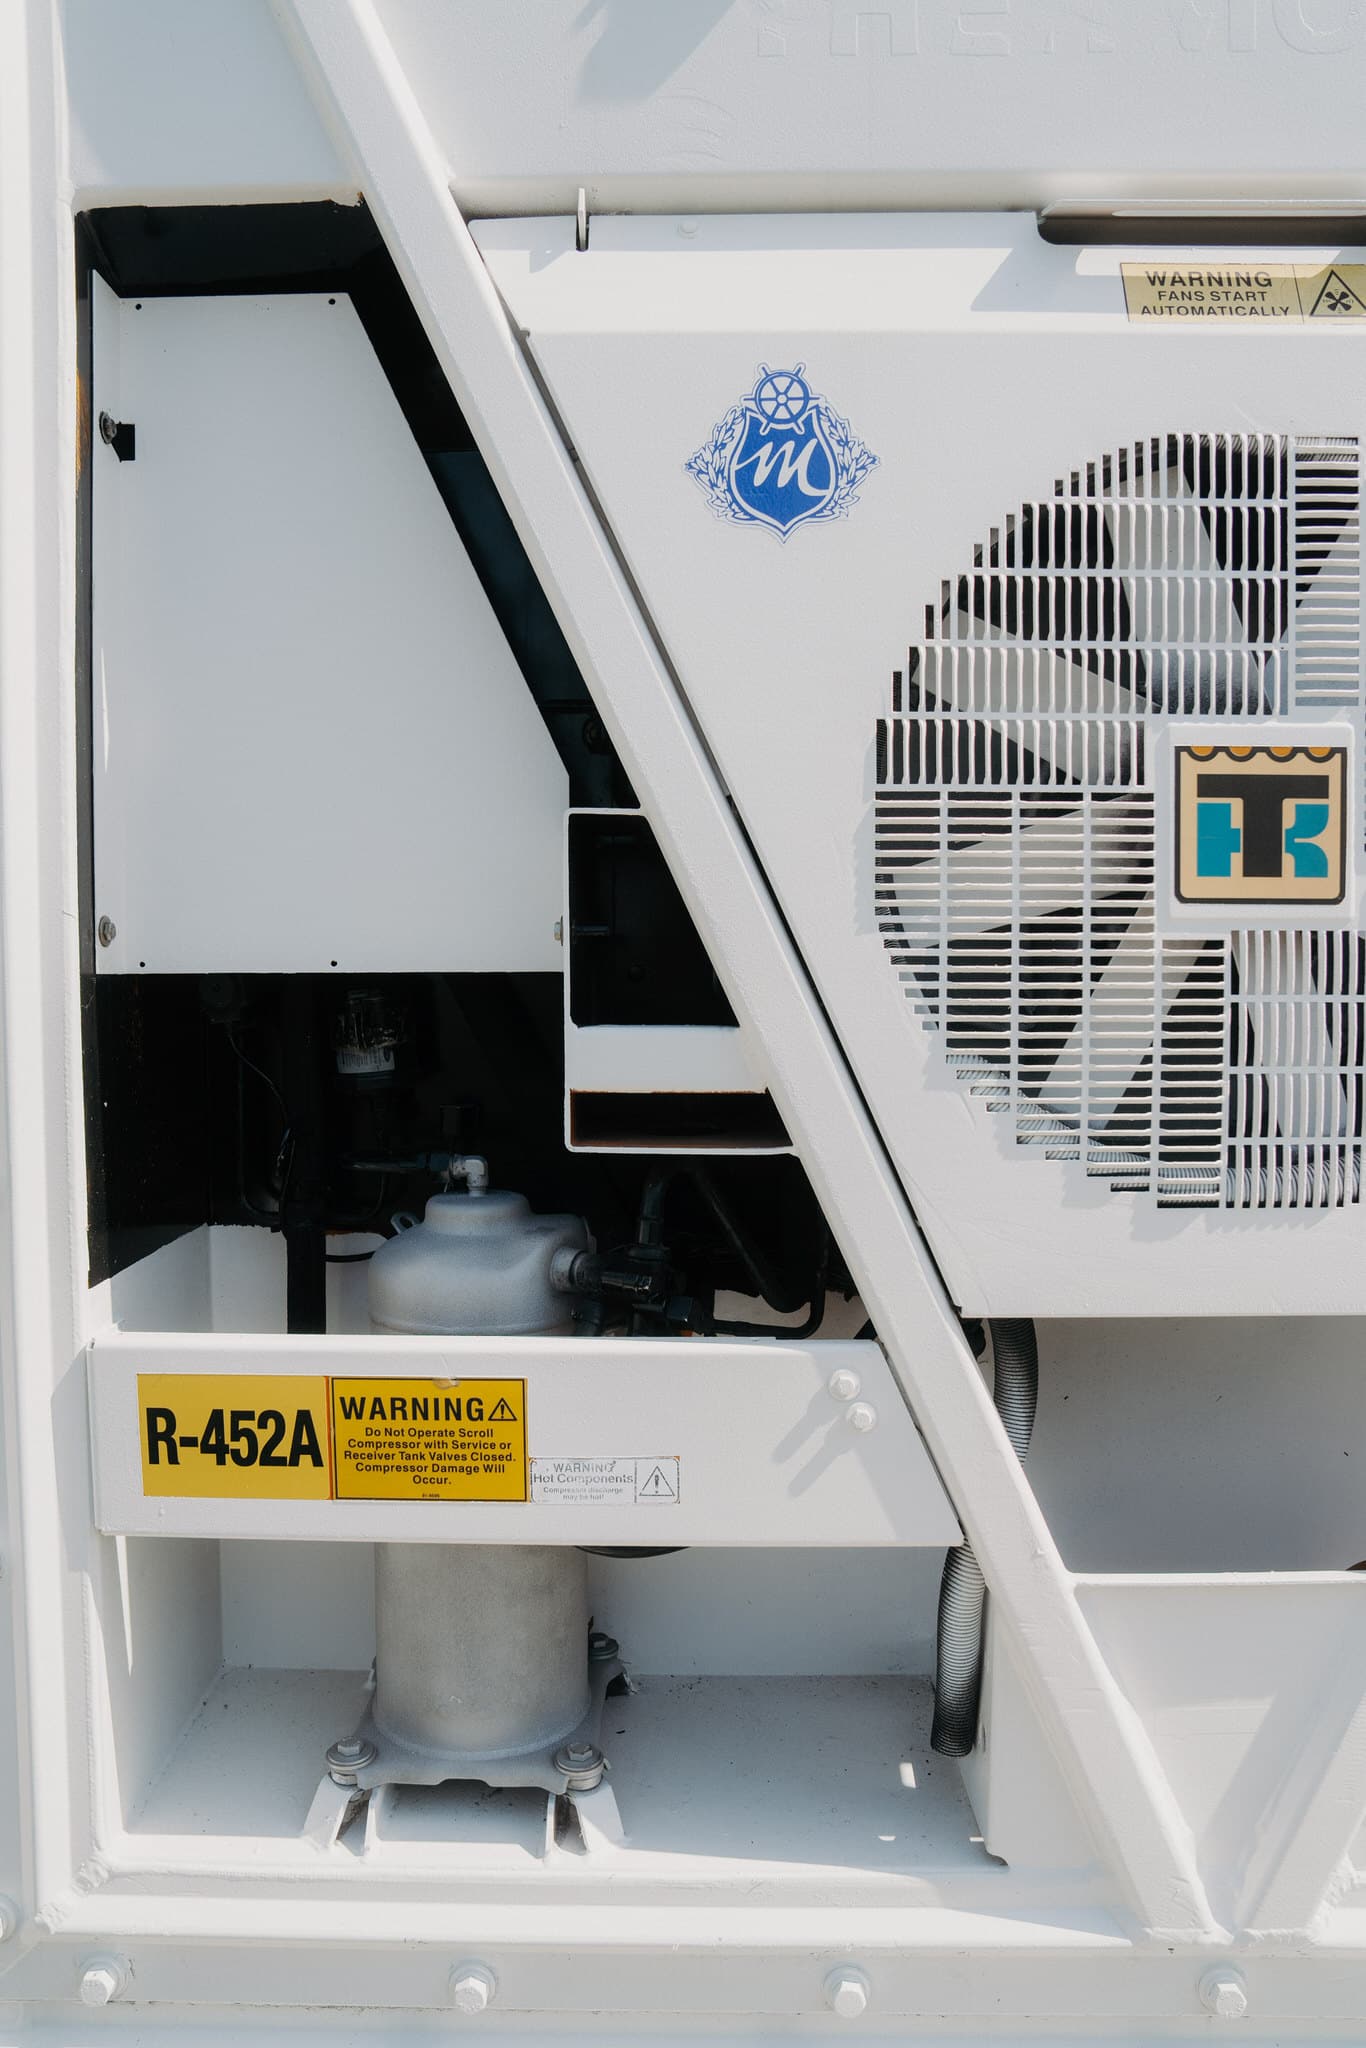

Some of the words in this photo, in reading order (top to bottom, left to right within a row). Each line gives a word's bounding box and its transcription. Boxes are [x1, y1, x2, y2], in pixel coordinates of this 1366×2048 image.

[1146, 272, 1272, 287] WARNING
[1158, 291, 1205, 301] FANS
[1210, 291, 1267, 301] START
[1142, 306, 1289, 316] AUTOMATICALLY
[340, 1397, 483, 1421] WARNING
[146, 1408, 324, 1467] R-452A
[366, 1427, 381, 1436] Do
[385, 1428, 404, 1437] Not
[408, 1428, 455, 1439] Operate
[459, 1428, 493, 1437] Scroll
[347, 1439, 421, 1450] Compressor
[424, 1440, 448, 1448] with
[452, 1440, 496, 1449] Service
[344, 1451, 395, 1460] Receiver
[399, 1451, 425, 1460] Tank
[429, 1452, 467, 1461] Valves
[471, 1452, 515, 1461] Closed.
[356, 1462, 428, 1473] Compressor
[432, 1464, 479, 1475] Damage
[483, 1464, 504, 1473] Will
[413, 1475, 451, 1484] Occur.
